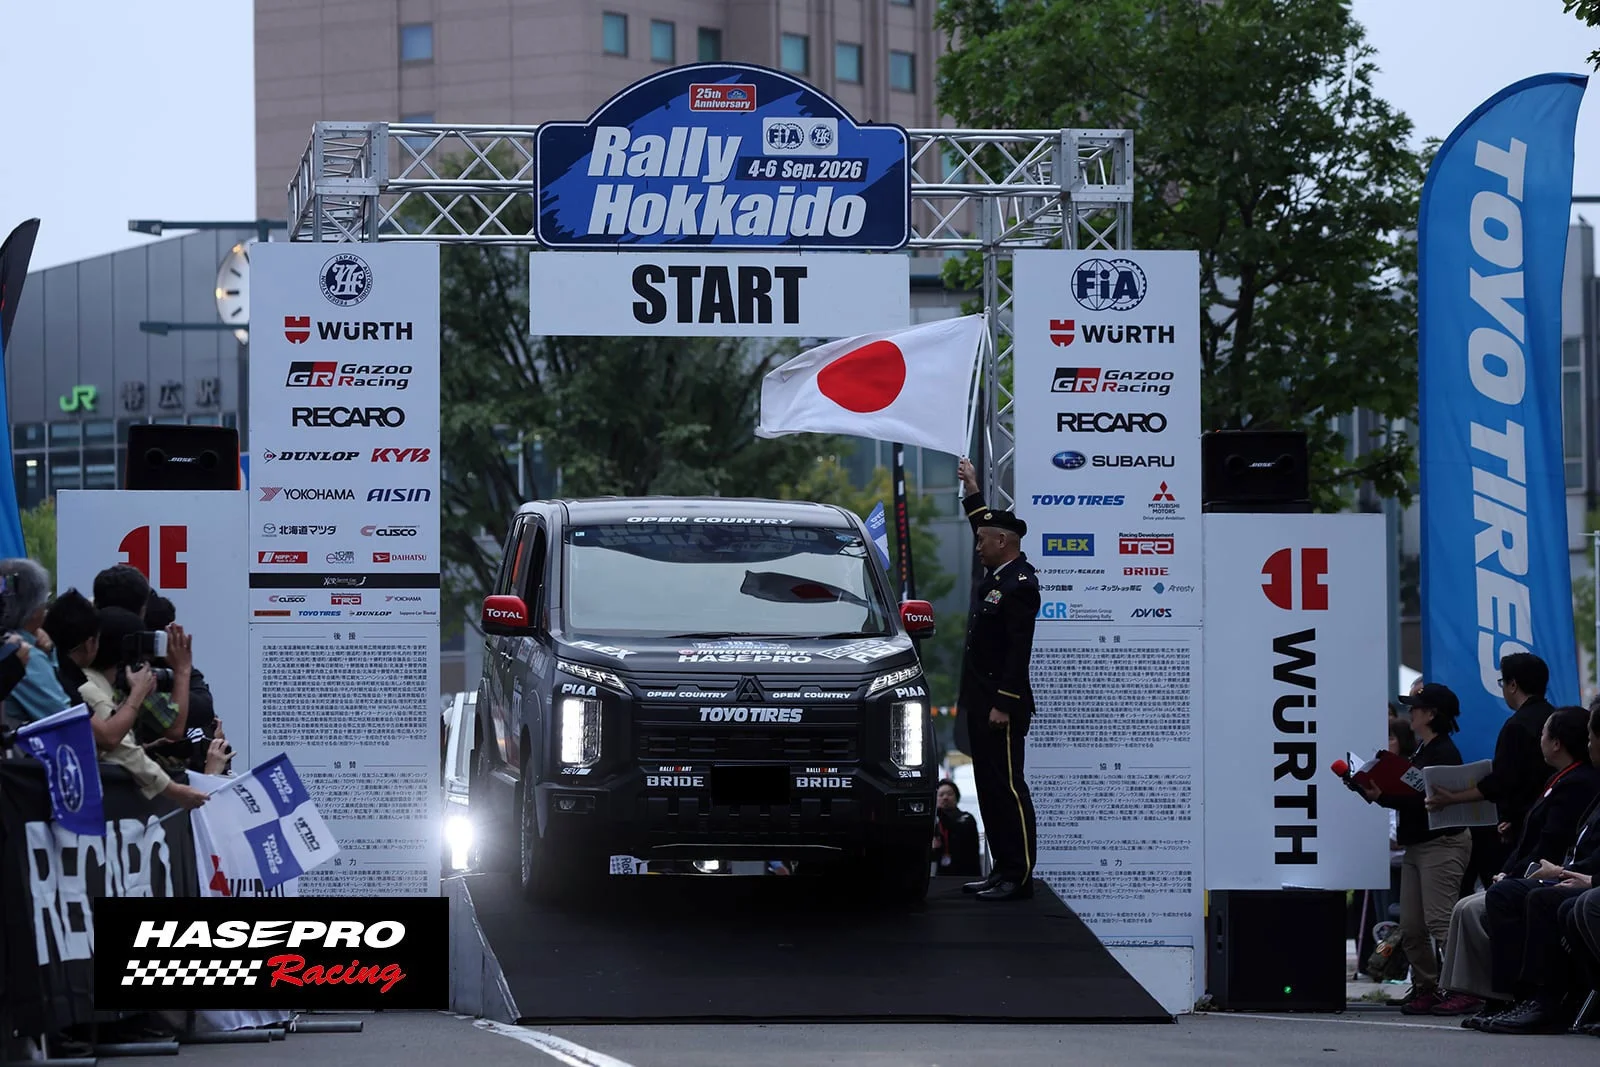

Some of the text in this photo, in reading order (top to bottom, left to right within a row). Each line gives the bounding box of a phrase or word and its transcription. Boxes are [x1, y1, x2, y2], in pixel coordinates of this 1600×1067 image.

[696, 88, 721, 98] 25th
[694, 100, 750, 108] Anniversary
[588, 126, 742, 183] Rally
[748, 160, 863, 181] 4-6 Sep.2026
[587, 184, 867, 238] Hokkaido
[632, 264, 808, 325] START
[317, 322, 412, 340] WÜRTH
[1082, 325, 1174, 344] WÜRTH
[288, 371, 334, 386] GR
[338, 376, 409, 390] Racing
[1053, 377, 1098, 392] GR
[1102, 382, 1170, 396] Racing
[60, 384, 96, 412] JR
[292, 406, 406, 428] RECARO
[1057, 412, 1168, 433] RECARO
[1468, 137, 1536, 699] TOYO TIRES
[278, 448, 431, 463] DUNLOP KYB
[1092, 455, 1175, 468] SUBARU
[284, 488, 431, 502] YOKOHAMA AISIN
[1032, 494, 1126, 506] TOYO TIRES
[625, 516, 793, 525] OPEN COUNTRY
[278, 525, 337, 536] 北海道マツダ
[376, 528, 417, 537] CUSCO
[1047, 538, 1090, 552] FLEX
[1120, 540, 1172, 554] TRD
[1123, 567, 1170, 576] BRIDE
[331, 596, 362, 604] TRD
[486, 608, 523, 620] TOTAL
[904, 612, 934, 622] TOTAL
[678, 654, 812, 664] HASEPRO
[562, 684, 597, 697] PIAA
[804, 692, 851, 700] COUNTRY
[894, 686, 926, 698] PIAA
[700, 707, 804, 722] TOYO TIRES
[1272, 628, 1318, 865] WÜRTH
[646, 775, 705, 788] BRIDE
[796, 776, 853, 789] BRIDE
[267, 833, 284, 865] TOYO
[334, 858, 357, 866] 協力
